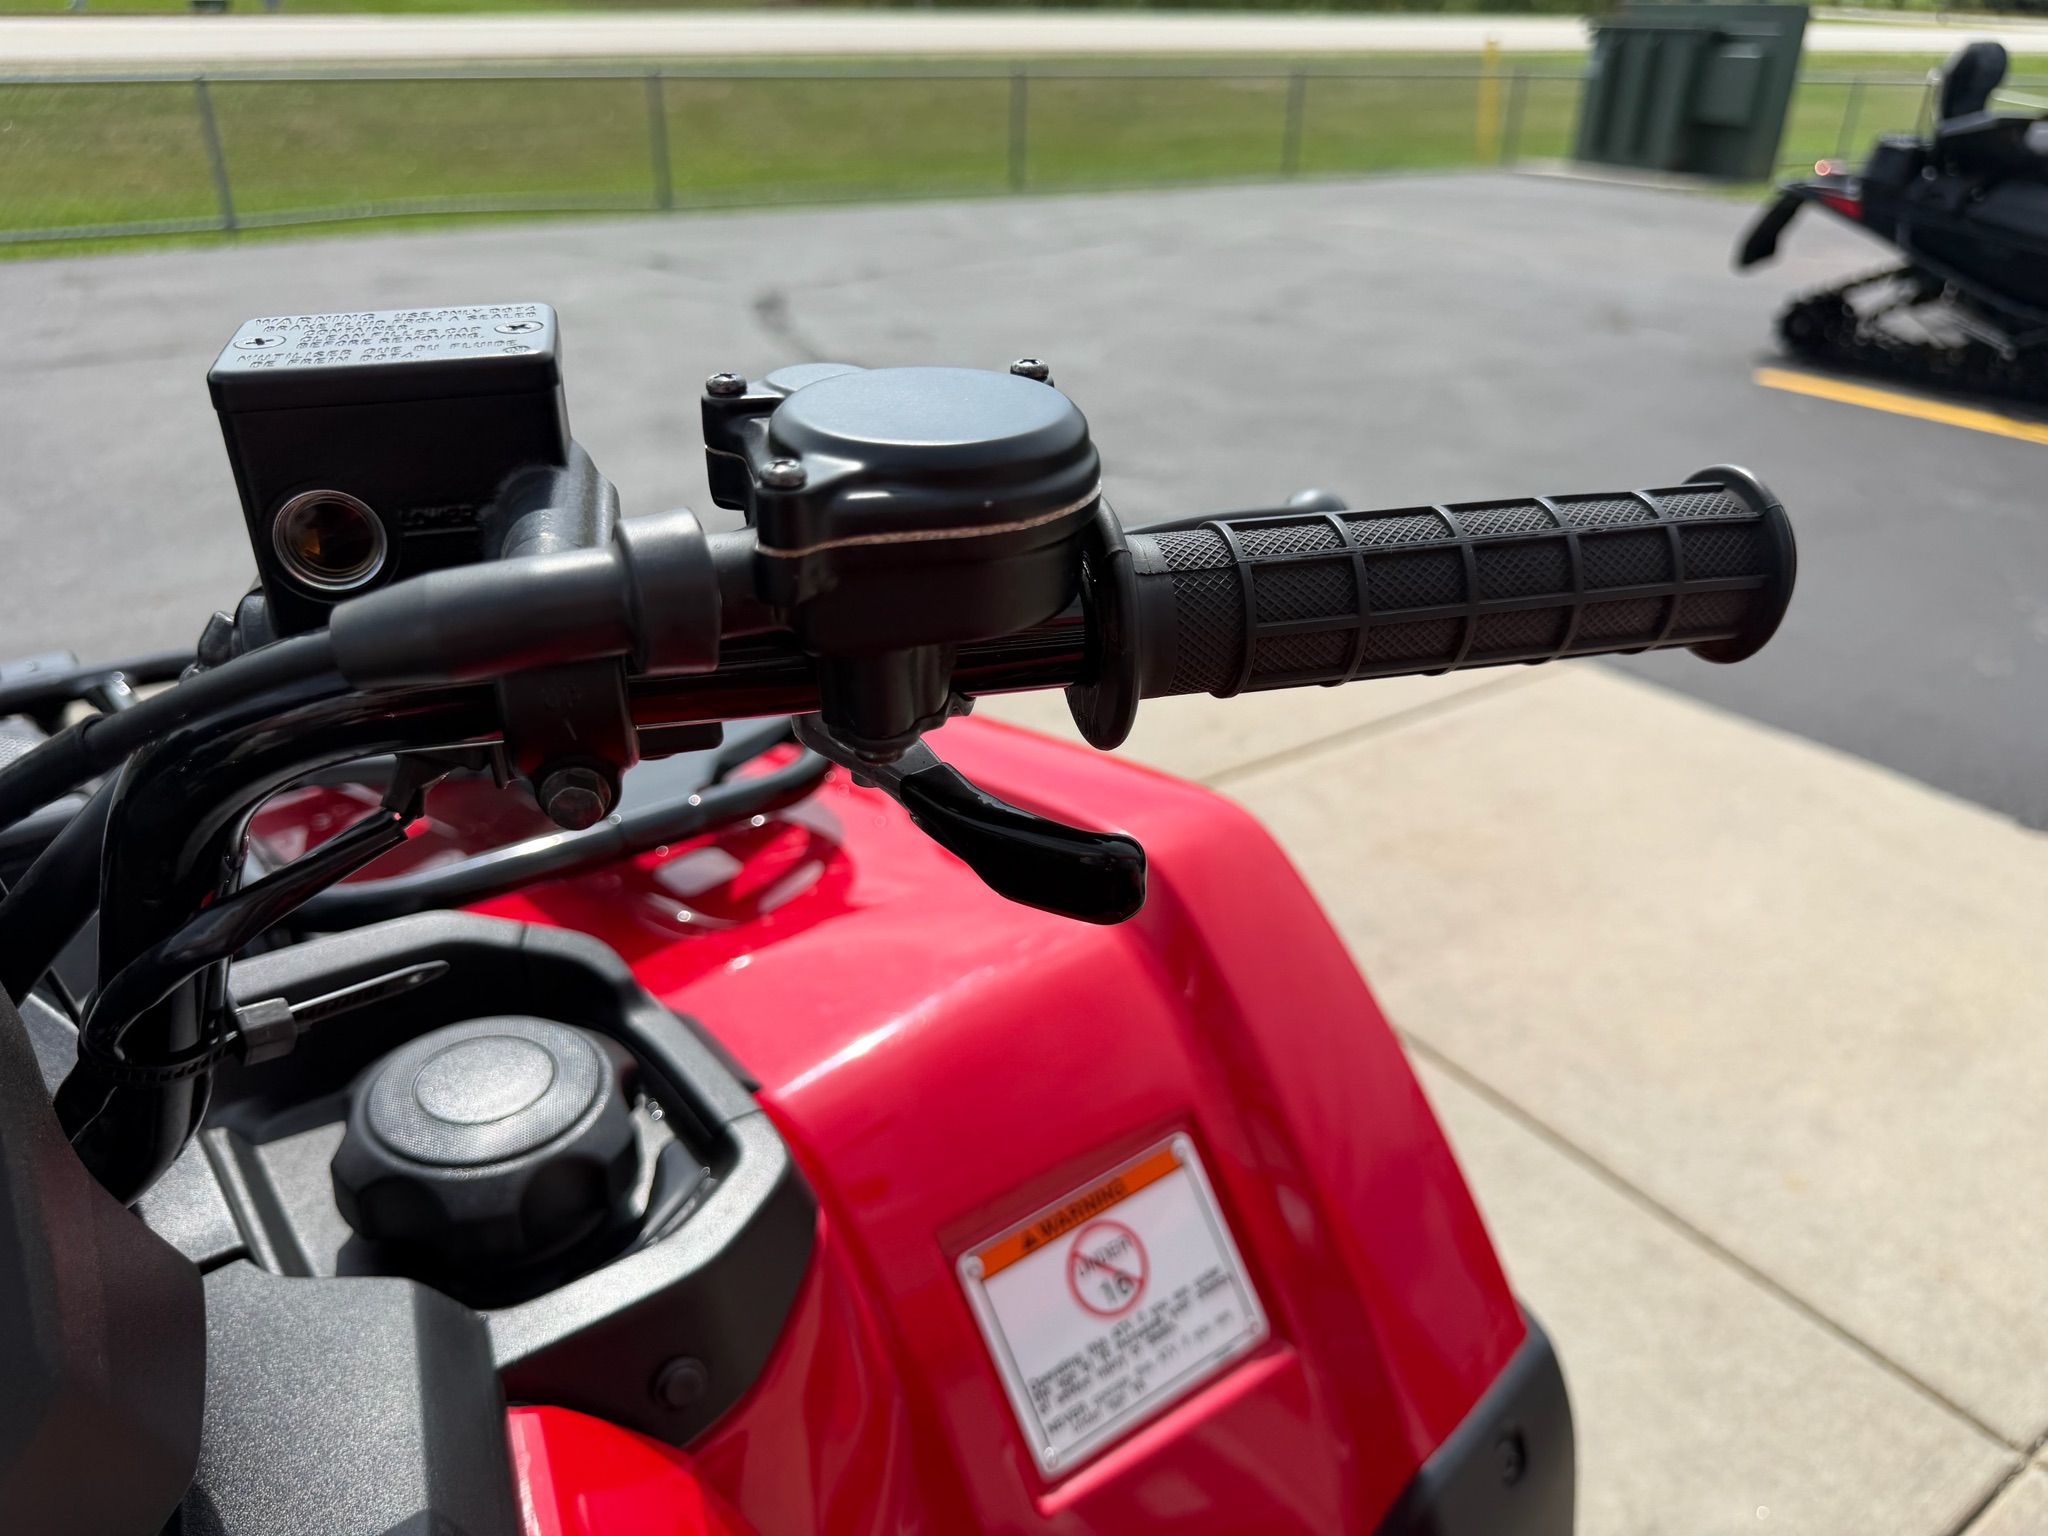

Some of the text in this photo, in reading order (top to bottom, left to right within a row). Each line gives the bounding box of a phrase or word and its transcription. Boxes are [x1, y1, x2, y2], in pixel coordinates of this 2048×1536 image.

[256, 305, 537, 327] WARNING USE ONLY DOT4
[263, 323, 327, 333] BRAKE
[333, 320, 386, 329] FLUID
[391, 317, 442, 325] FROM
[467, 312, 537, 321] SEALED
[299, 326, 482, 342] CLEAN FILLER CAP
[296, 339, 372, 349] BEFORE
[364, 346, 403, 355] QUE
[414, 344, 440, 352] DU
[449, 339, 518, 349] FLUIDE
[249, 360, 277, 369] DE
[286, 356, 349, 367] FREIN
[1038, 1175, 1127, 1240] WARNING
